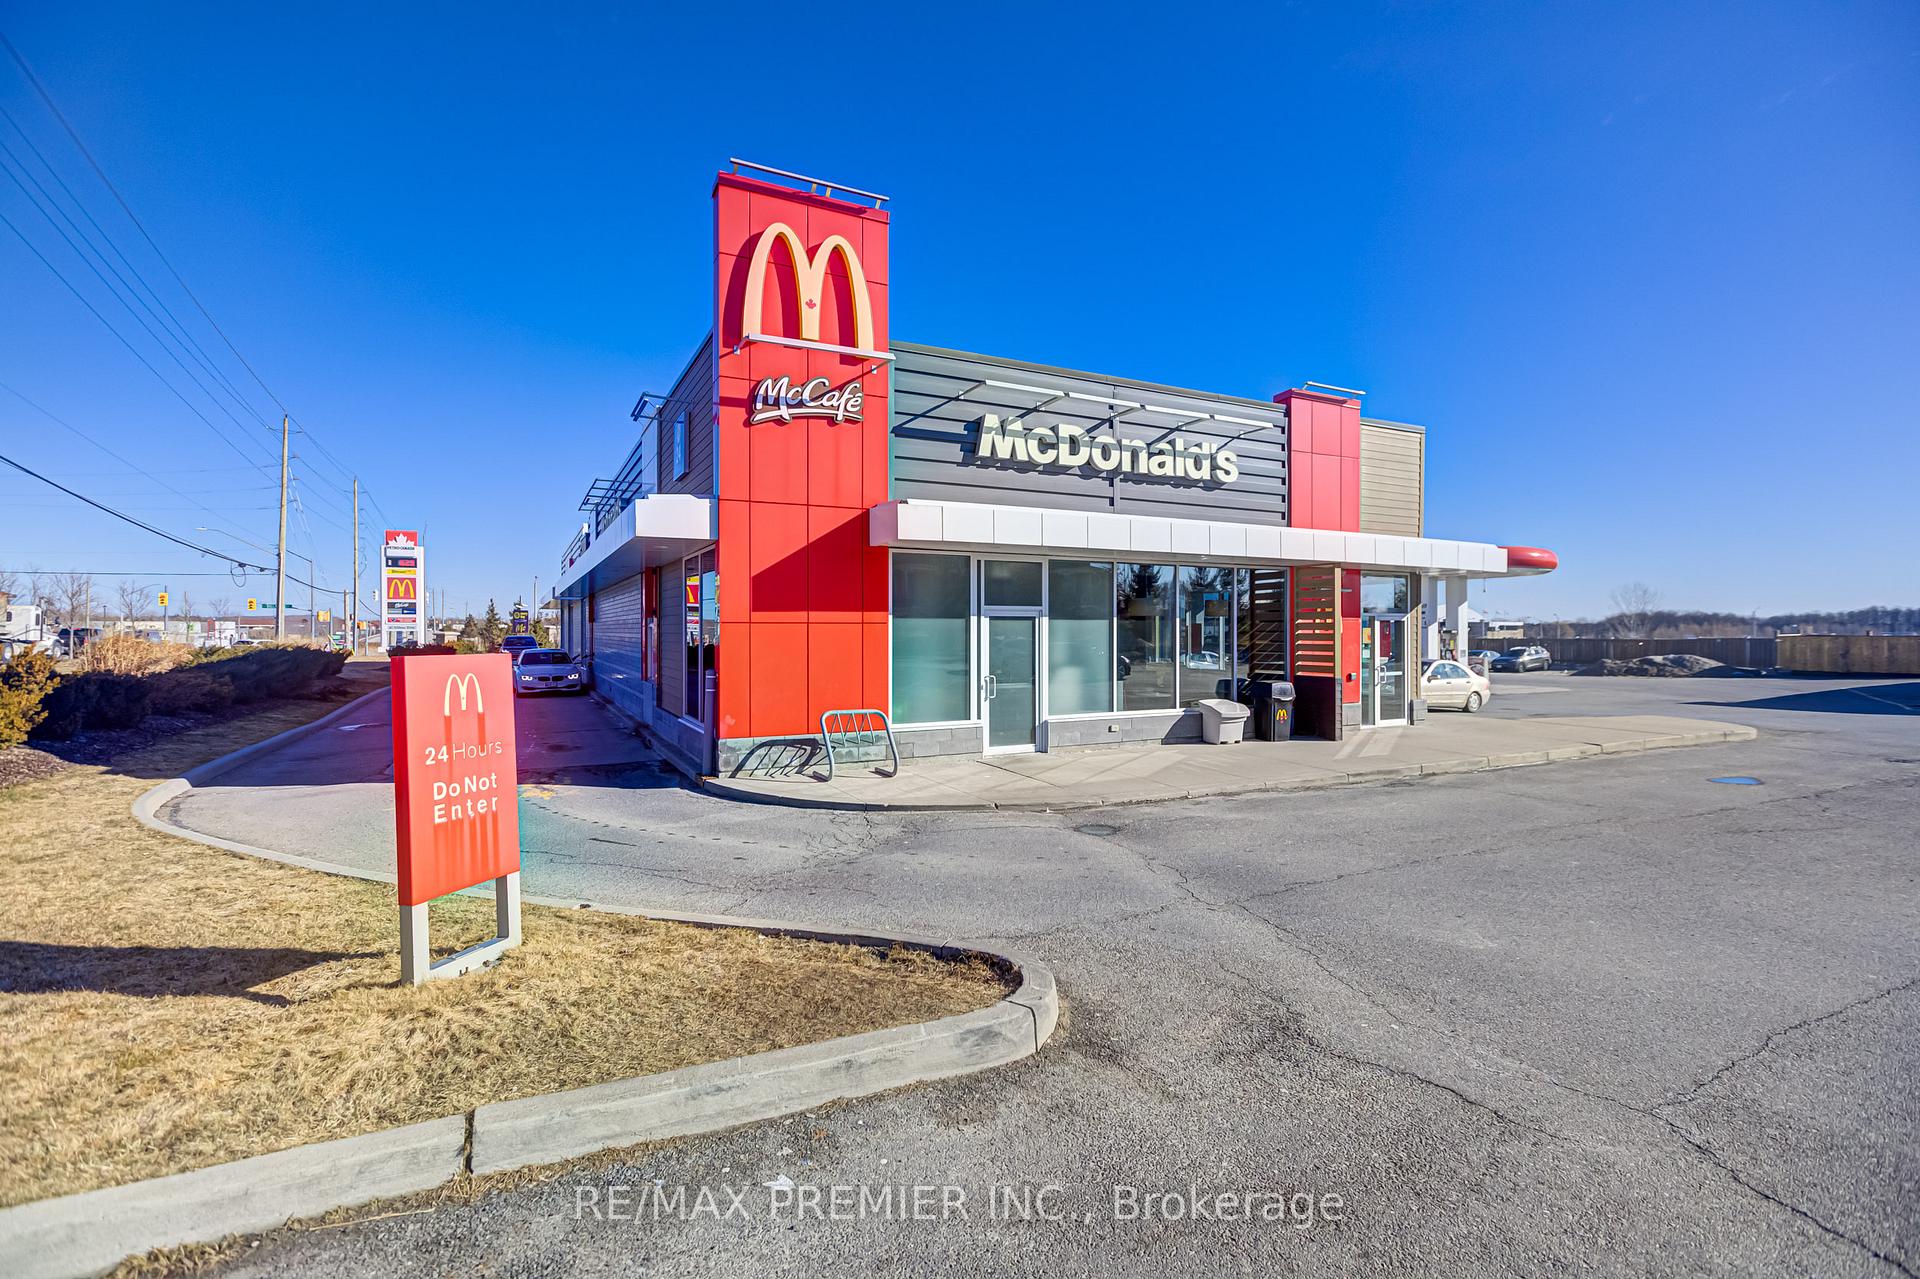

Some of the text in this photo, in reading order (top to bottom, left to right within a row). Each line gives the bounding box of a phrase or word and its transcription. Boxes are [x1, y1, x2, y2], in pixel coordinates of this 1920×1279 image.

[754, 376, 863, 421] McCafé
[975, 413, 1240, 484] McDonald's
[424, 740, 503, 766] 24 Hours
[433, 795, 499, 825] Enter
